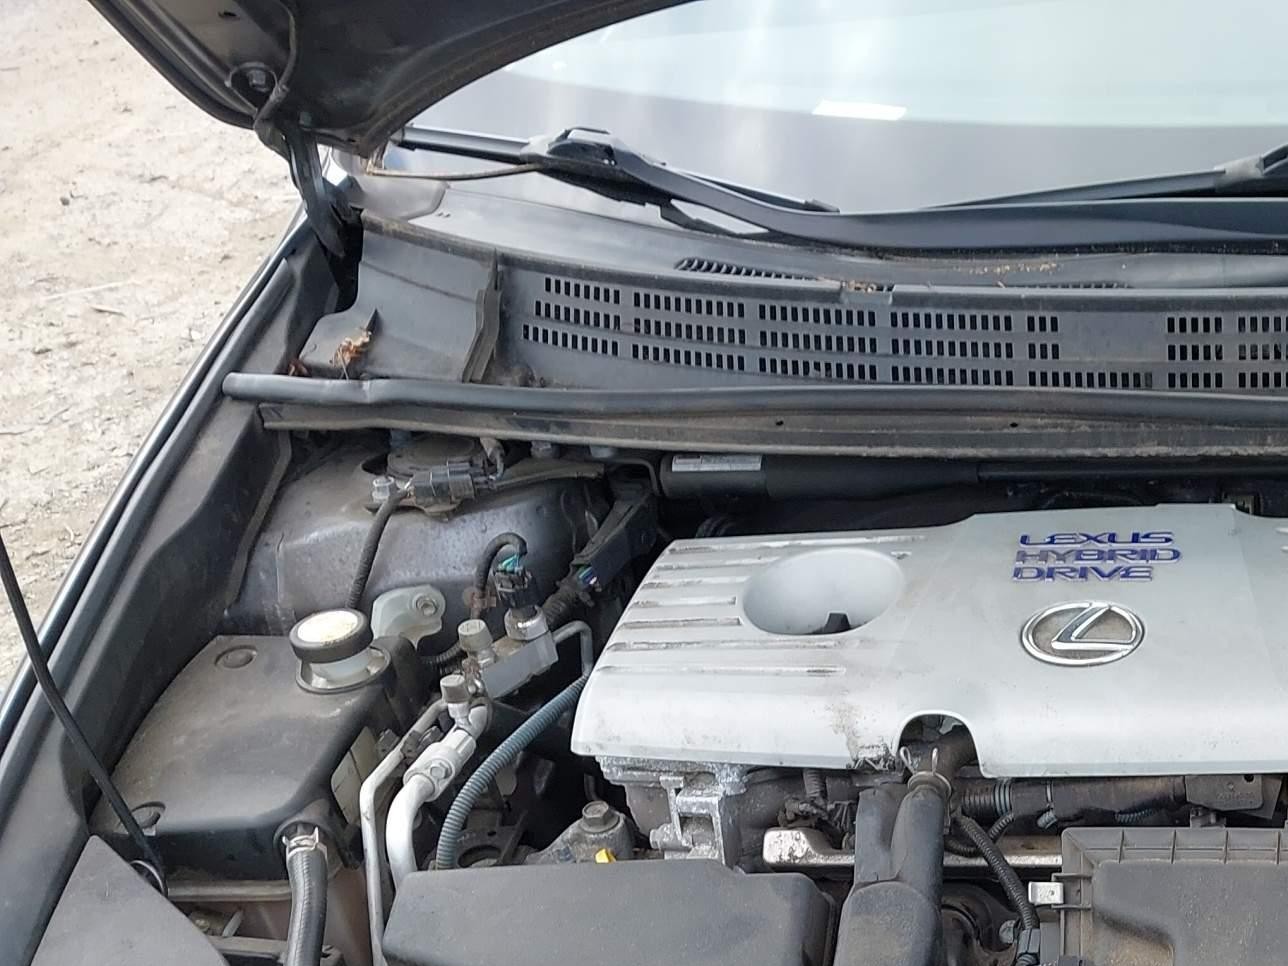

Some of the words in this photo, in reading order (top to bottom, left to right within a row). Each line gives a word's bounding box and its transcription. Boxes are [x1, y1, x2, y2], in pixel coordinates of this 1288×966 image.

[1019, 532, 1174, 547] LEXUS
[1015, 548, 1182, 564] HYBRID
[1012, 565, 1154, 582] DRIVE
